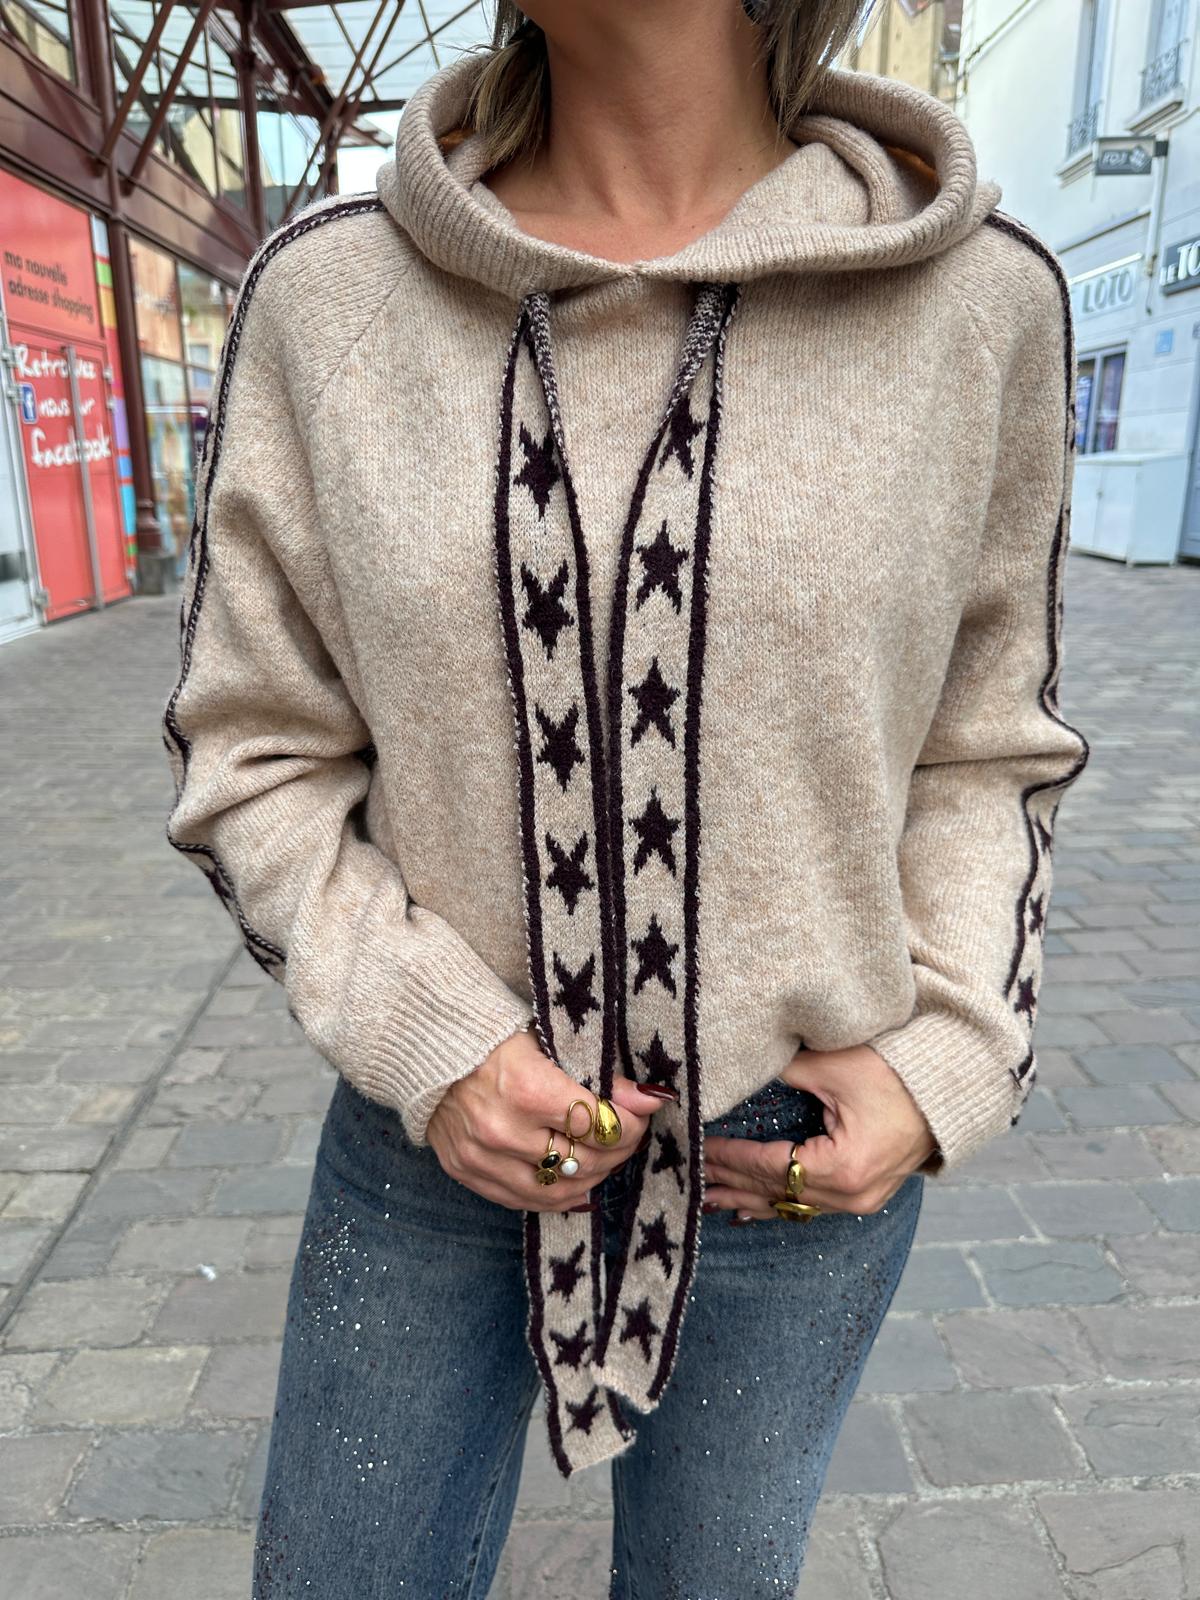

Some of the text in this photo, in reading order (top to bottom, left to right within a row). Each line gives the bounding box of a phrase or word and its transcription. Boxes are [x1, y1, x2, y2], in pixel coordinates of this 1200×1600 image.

[8, 274, 95, 324] adresse shopping
[1082, 269, 1132, 313] LOTO
[39, 397, 71, 417] nous
